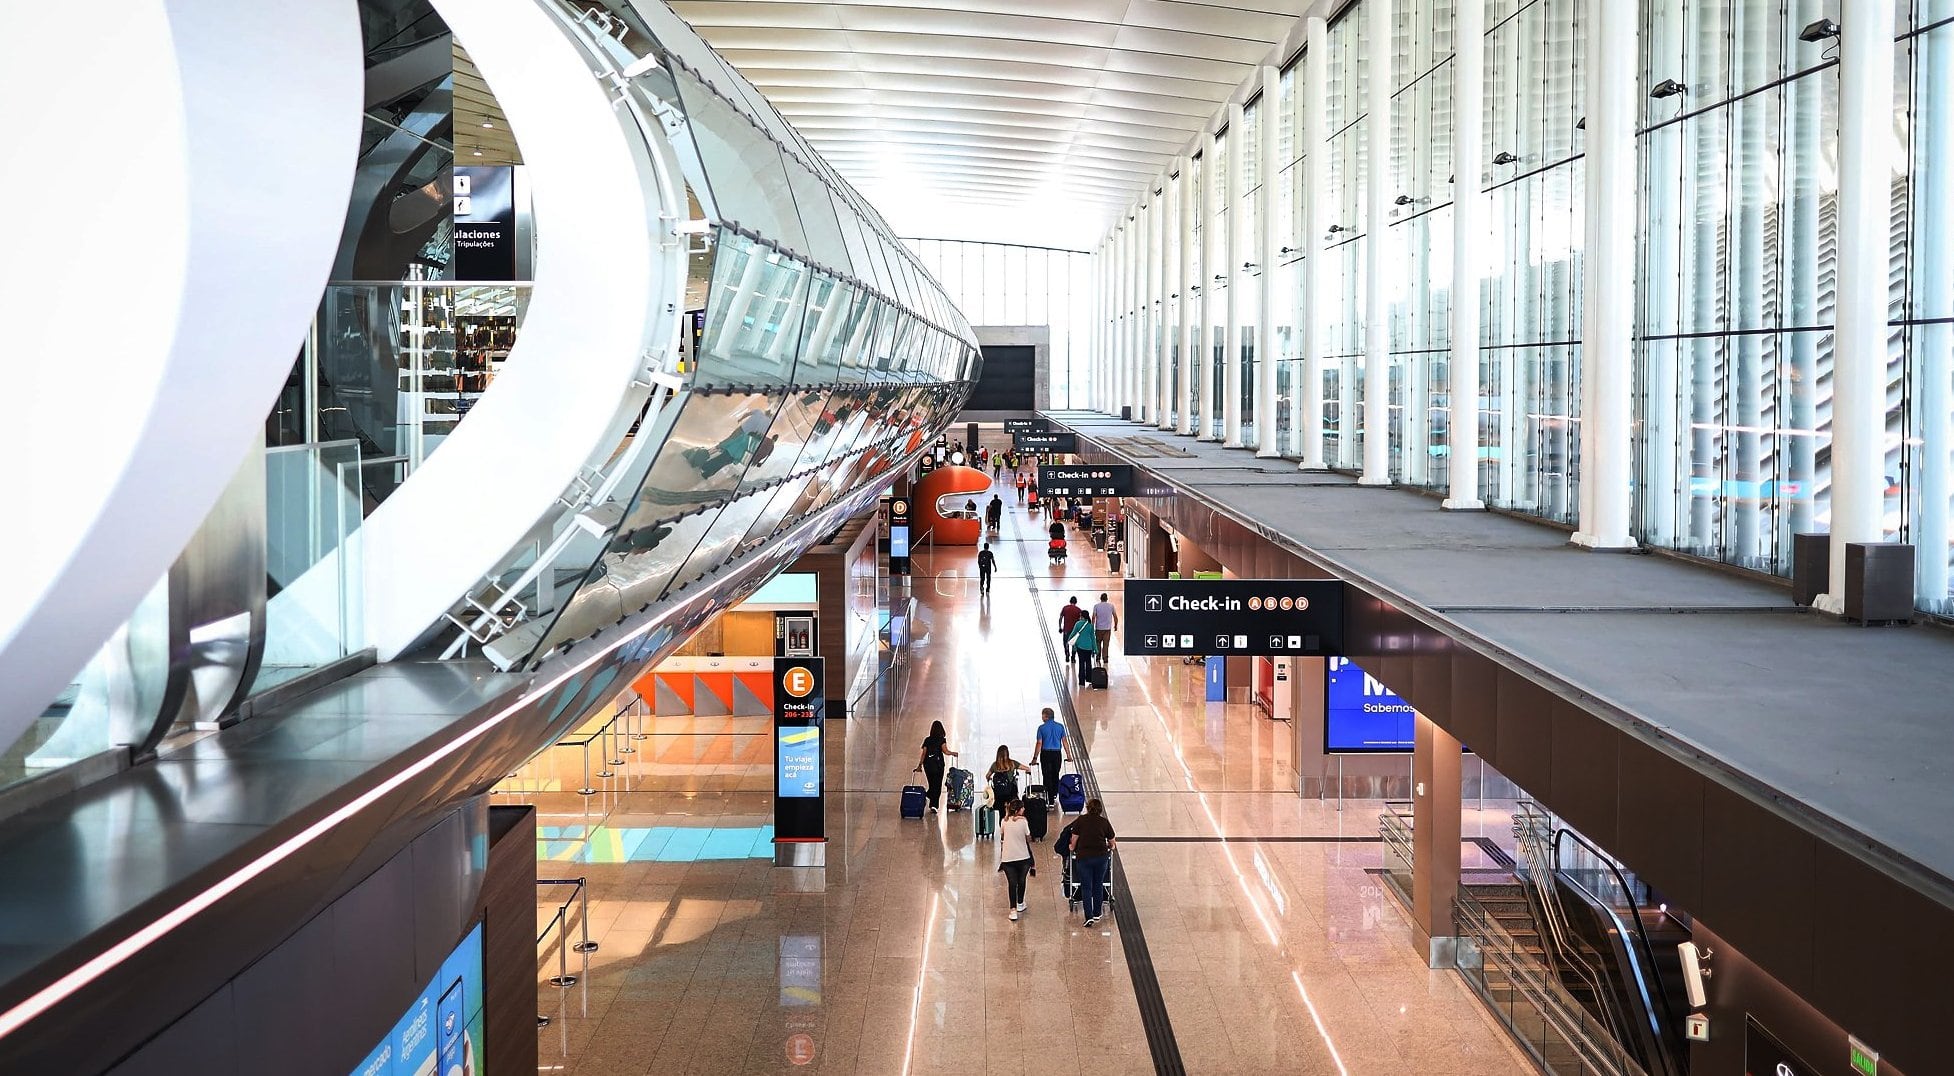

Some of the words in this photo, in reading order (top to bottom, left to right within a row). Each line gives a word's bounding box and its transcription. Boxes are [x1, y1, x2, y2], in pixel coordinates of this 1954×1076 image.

[1057, 471, 1089, 479] Check-in
[1168, 595, 1241, 611] Check-in
[792, 672, 806, 692] E
[1363, 703, 1415, 713] Sabemos
[795, 756, 812, 764] viaje
[1852, 1048, 1875, 1076] SALIDA
